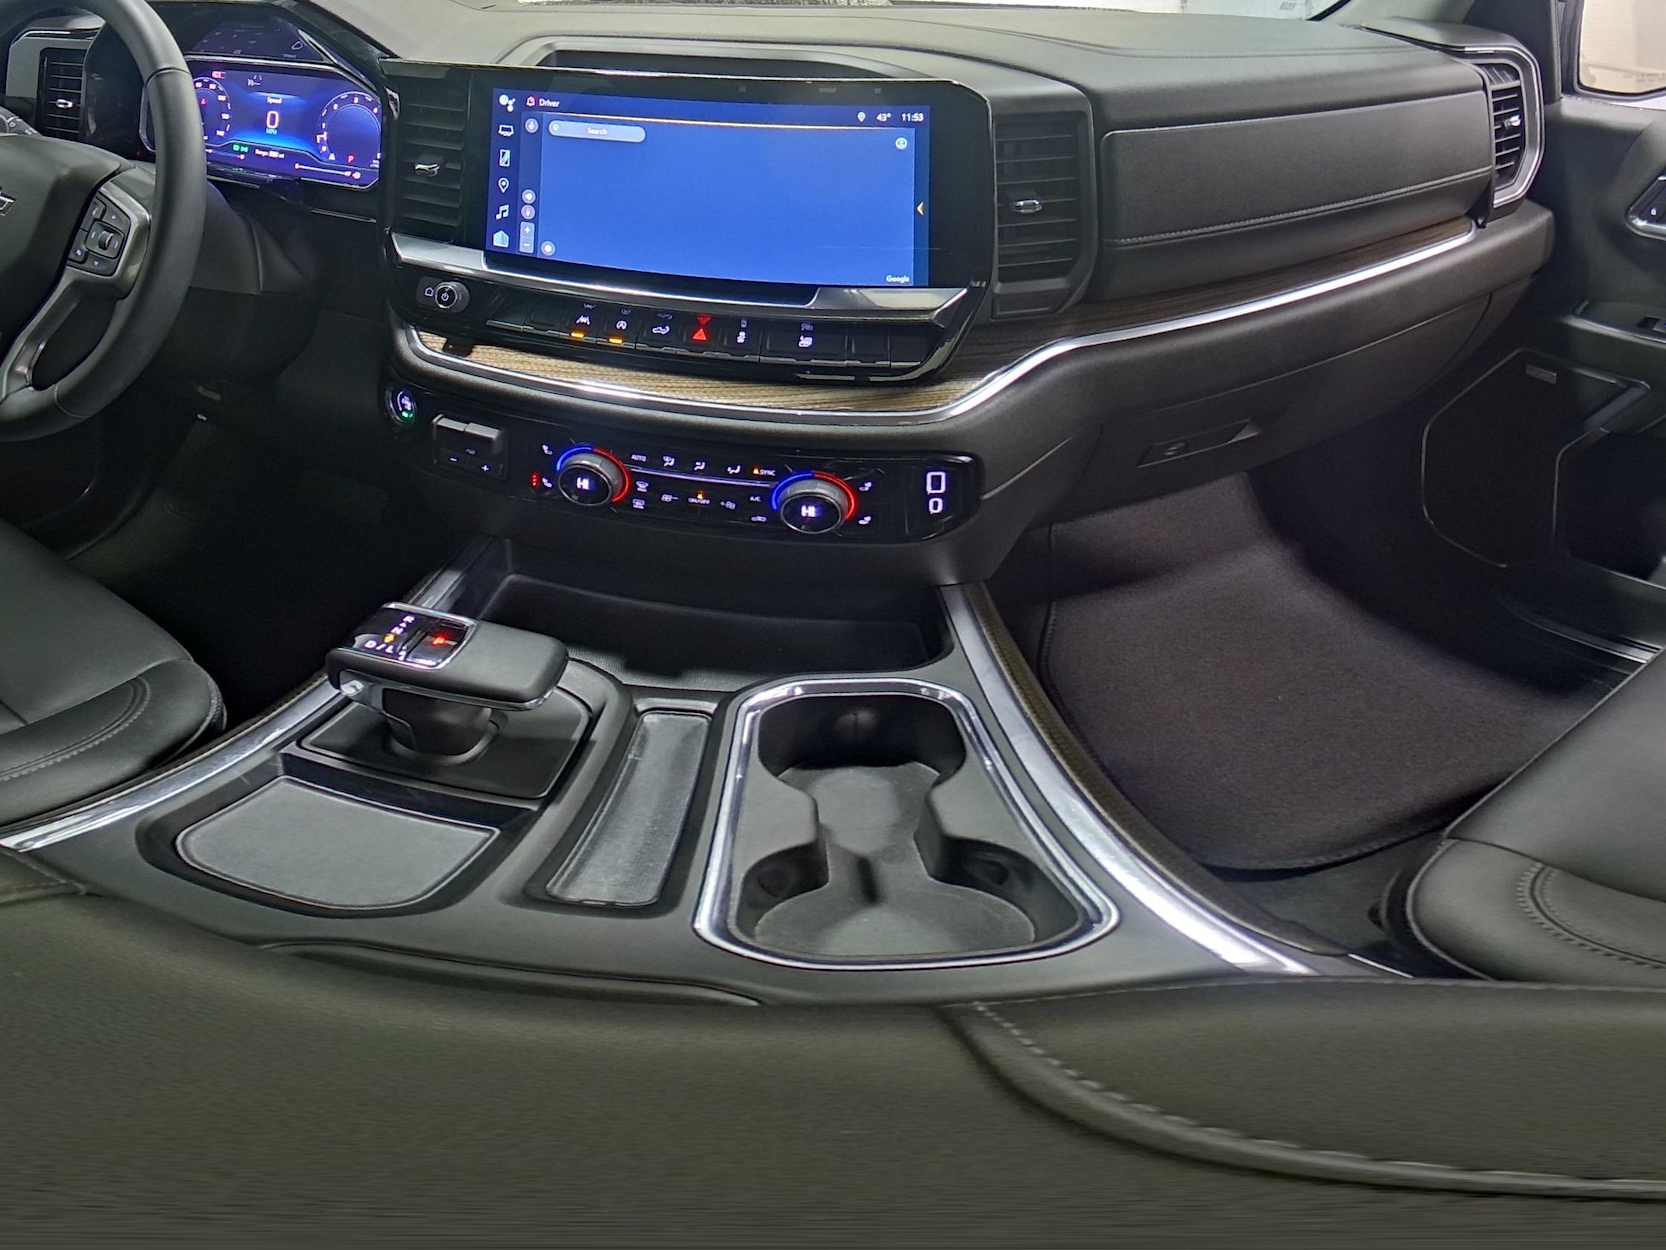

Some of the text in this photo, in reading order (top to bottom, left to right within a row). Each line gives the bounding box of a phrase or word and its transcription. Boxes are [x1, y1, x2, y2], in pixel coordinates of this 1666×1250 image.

[539, 98, 560, 108] Driver
[267, 111, 279, 129] 0
[876, 112, 924, 122] 43° 11:53
[587, 126, 608, 136] Search
[886, 274, 910, 284] Google
[631, 454, 646, 462] AUTO
